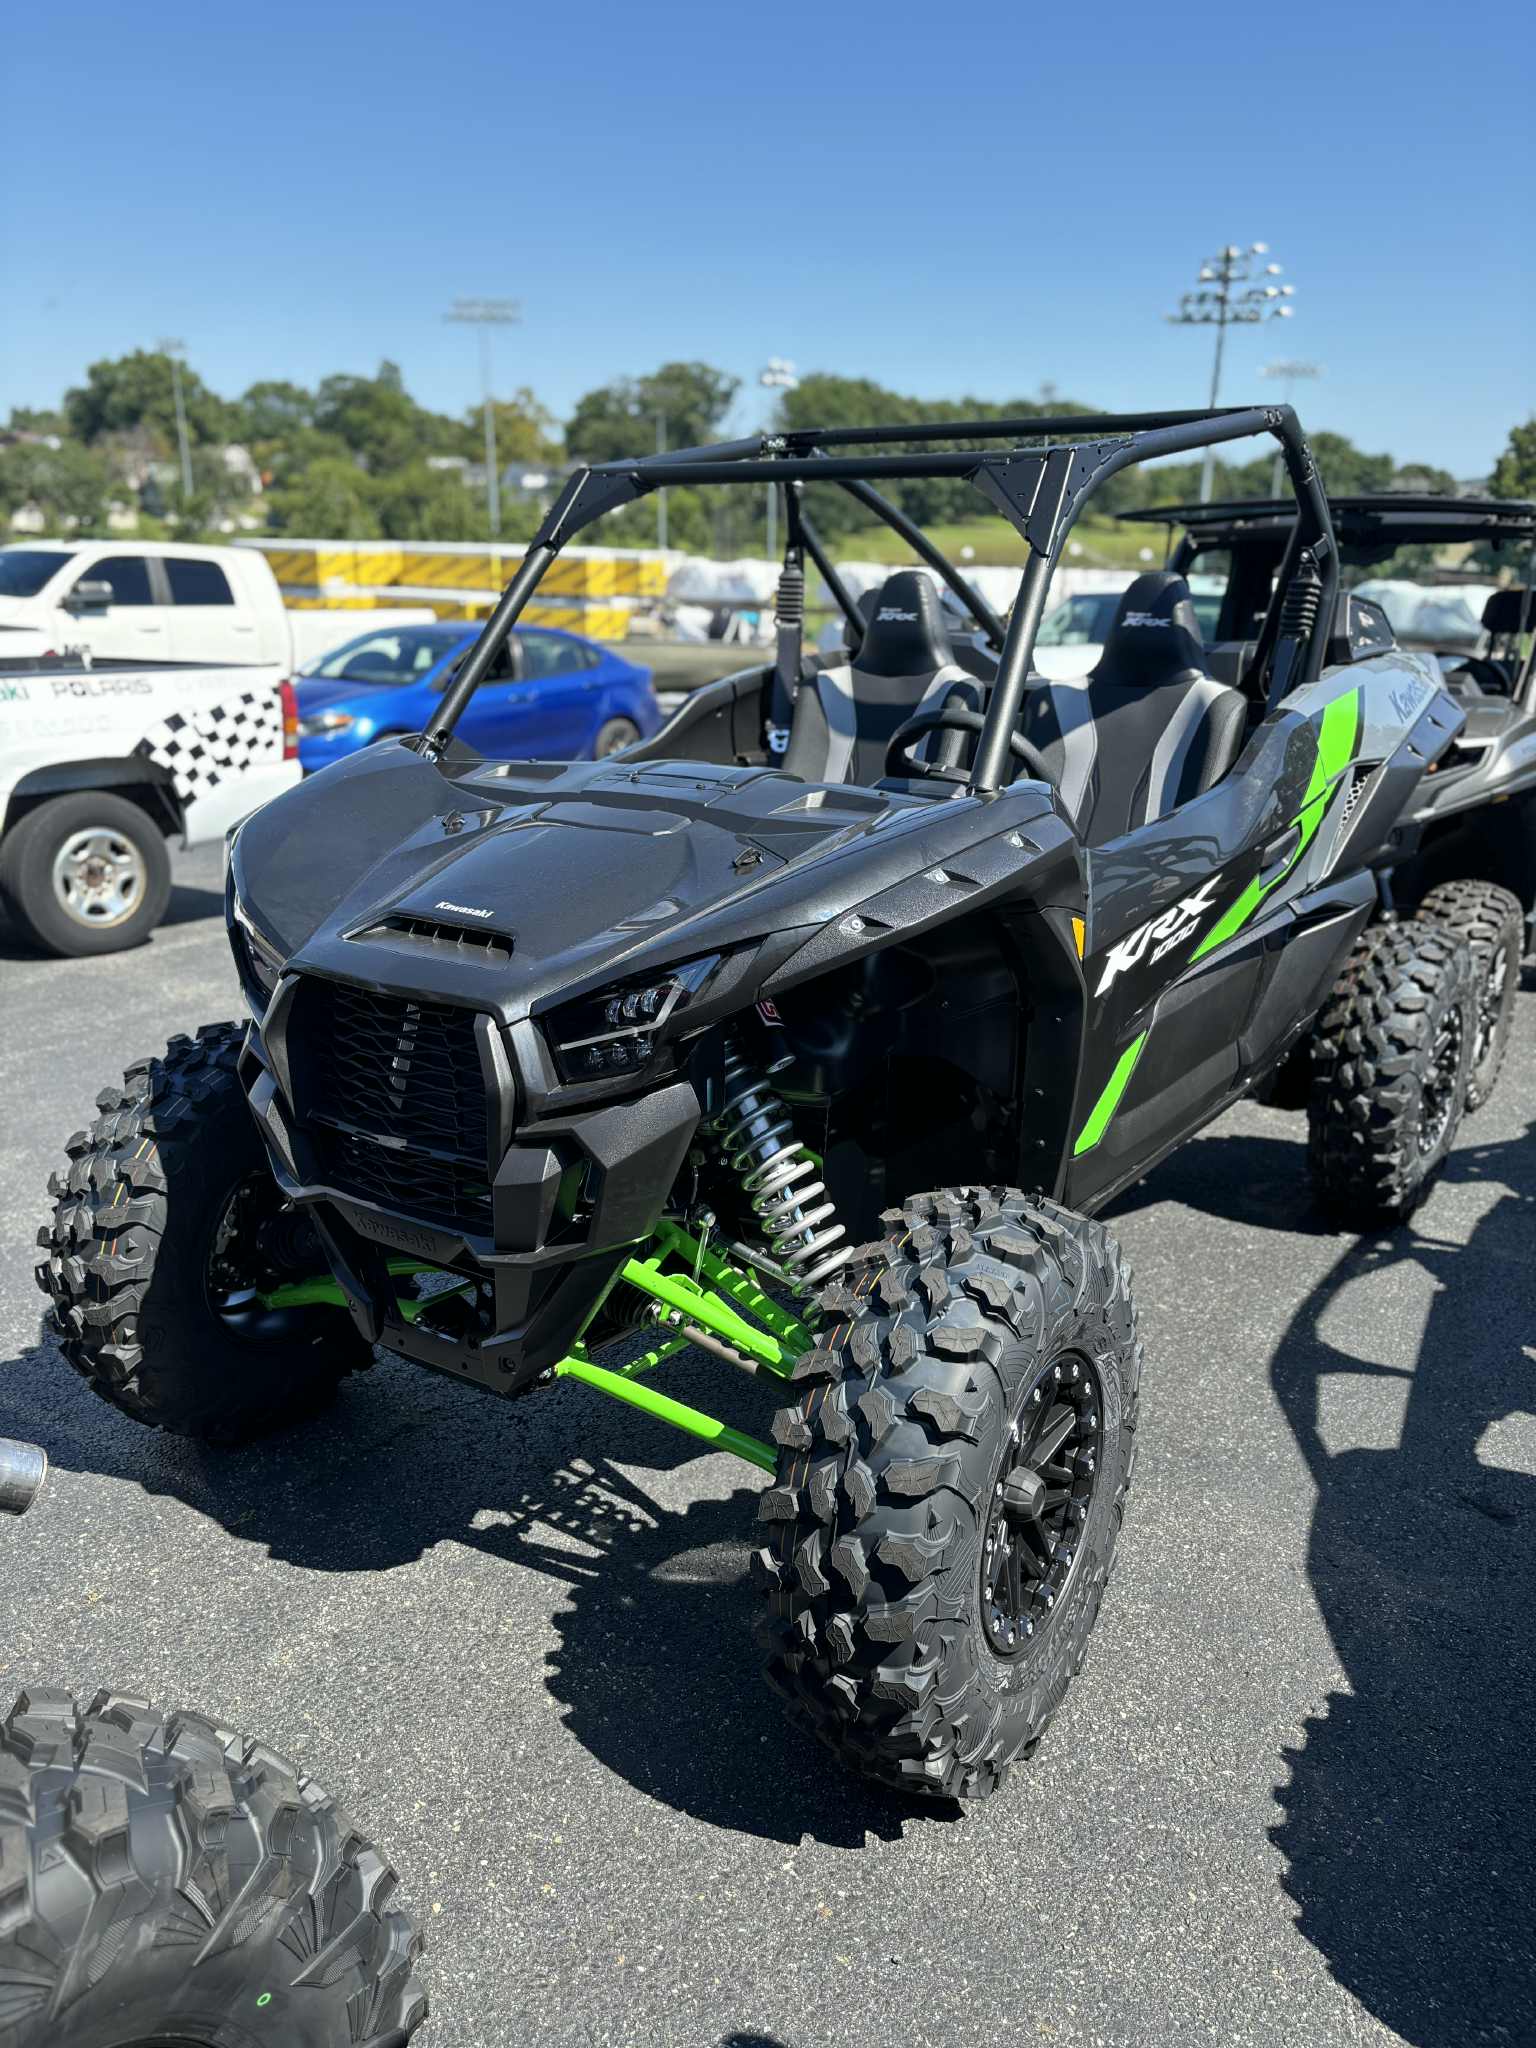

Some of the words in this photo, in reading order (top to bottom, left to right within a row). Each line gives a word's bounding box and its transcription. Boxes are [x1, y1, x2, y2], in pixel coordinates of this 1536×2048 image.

[435, 901, 494, 919] Kawasaki
[1094, 873, 1223, 998] KRX
[1148, 916, 1201, 966] 1000
[352, 1210, 437, 1251] Kawasaki
